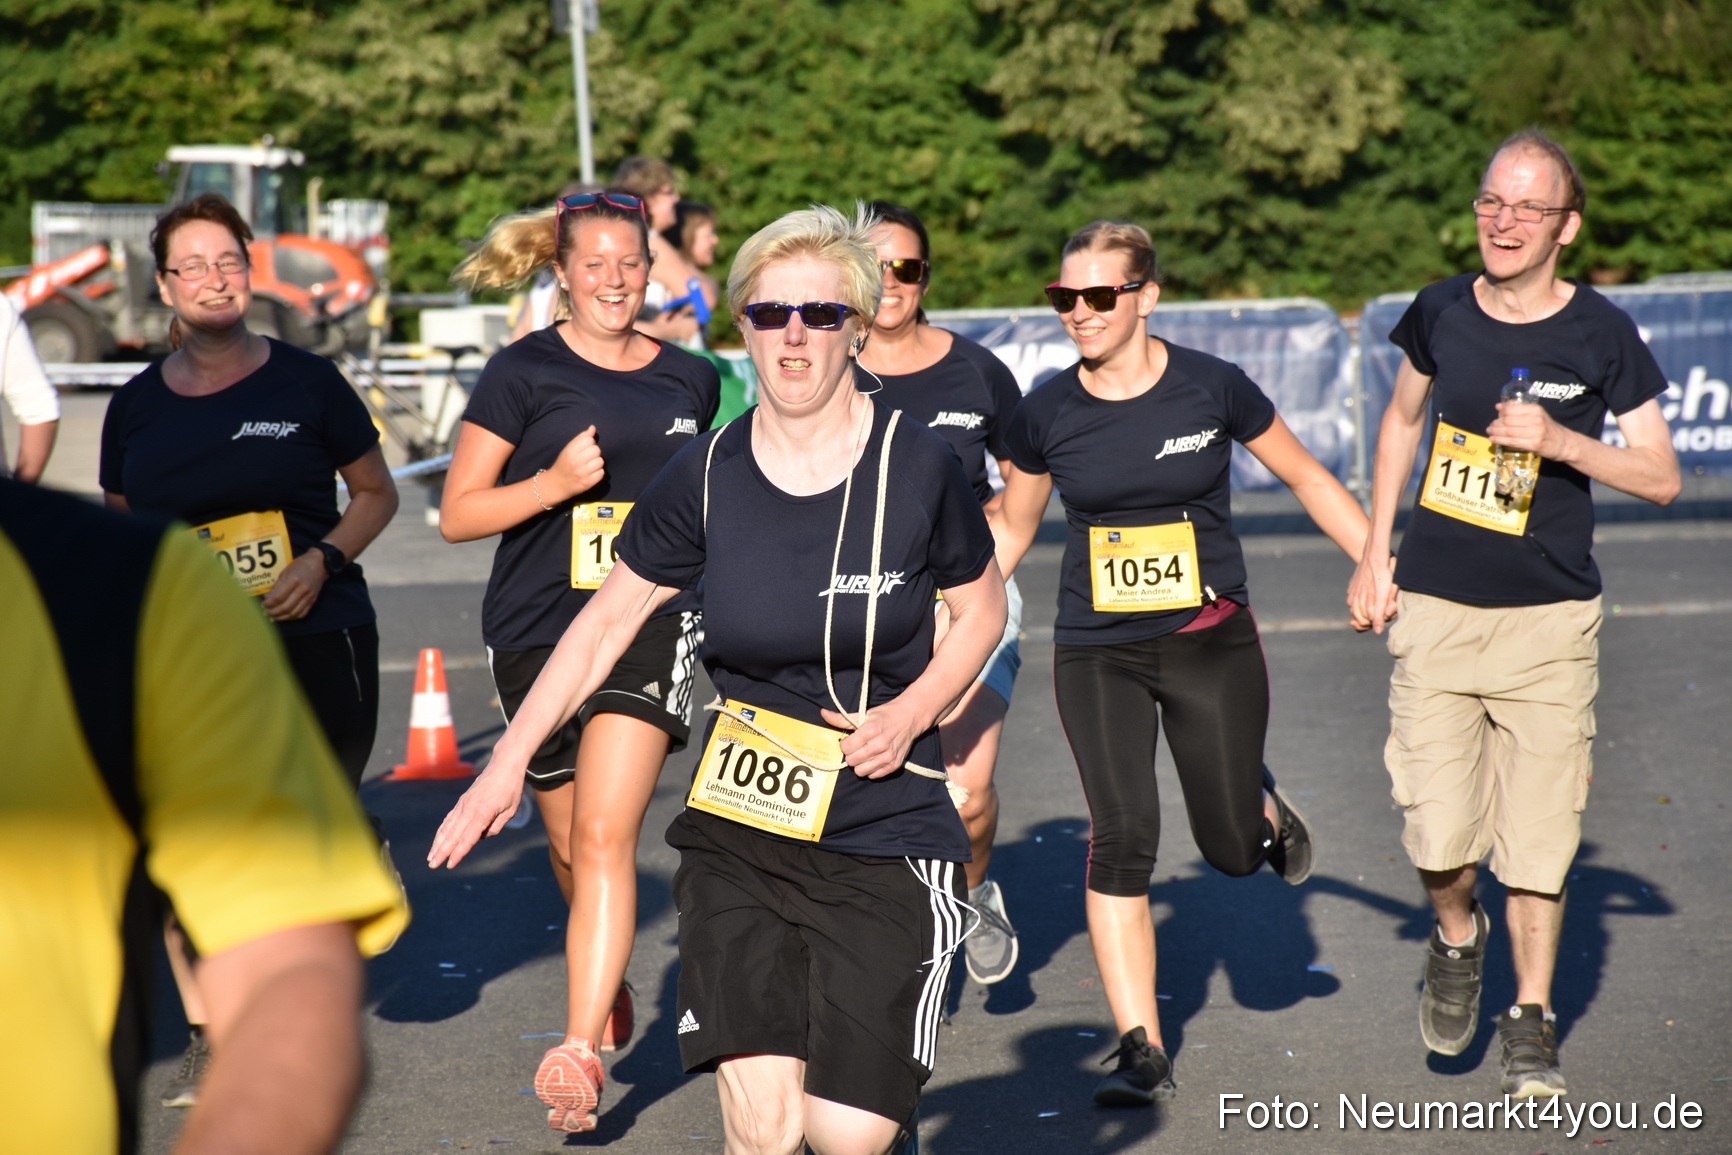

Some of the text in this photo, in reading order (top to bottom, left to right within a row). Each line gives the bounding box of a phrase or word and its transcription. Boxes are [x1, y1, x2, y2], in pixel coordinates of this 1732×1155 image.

[232, 422, 281, 440] JURA
[665, 418, 696, 435] JURA
[928, 411, 971, 428] JURA
[1155, 434, 1201, 460] JURA
[216, 540, 278, 576] 055
[1104, 555, 1183, 587] 1054
[1116, 588, 1172, 597] Meier Andrea
[717, 742, 814, 804] 1086
[706, 780, 746, 801] Lehmann
[747, 793, 807, 819] Dominique
[707, 794, 743, 810] Lebenshilfe
[744, 805, 778, 821] Neumarkt
[779, 815, 794, 826] e.V.
